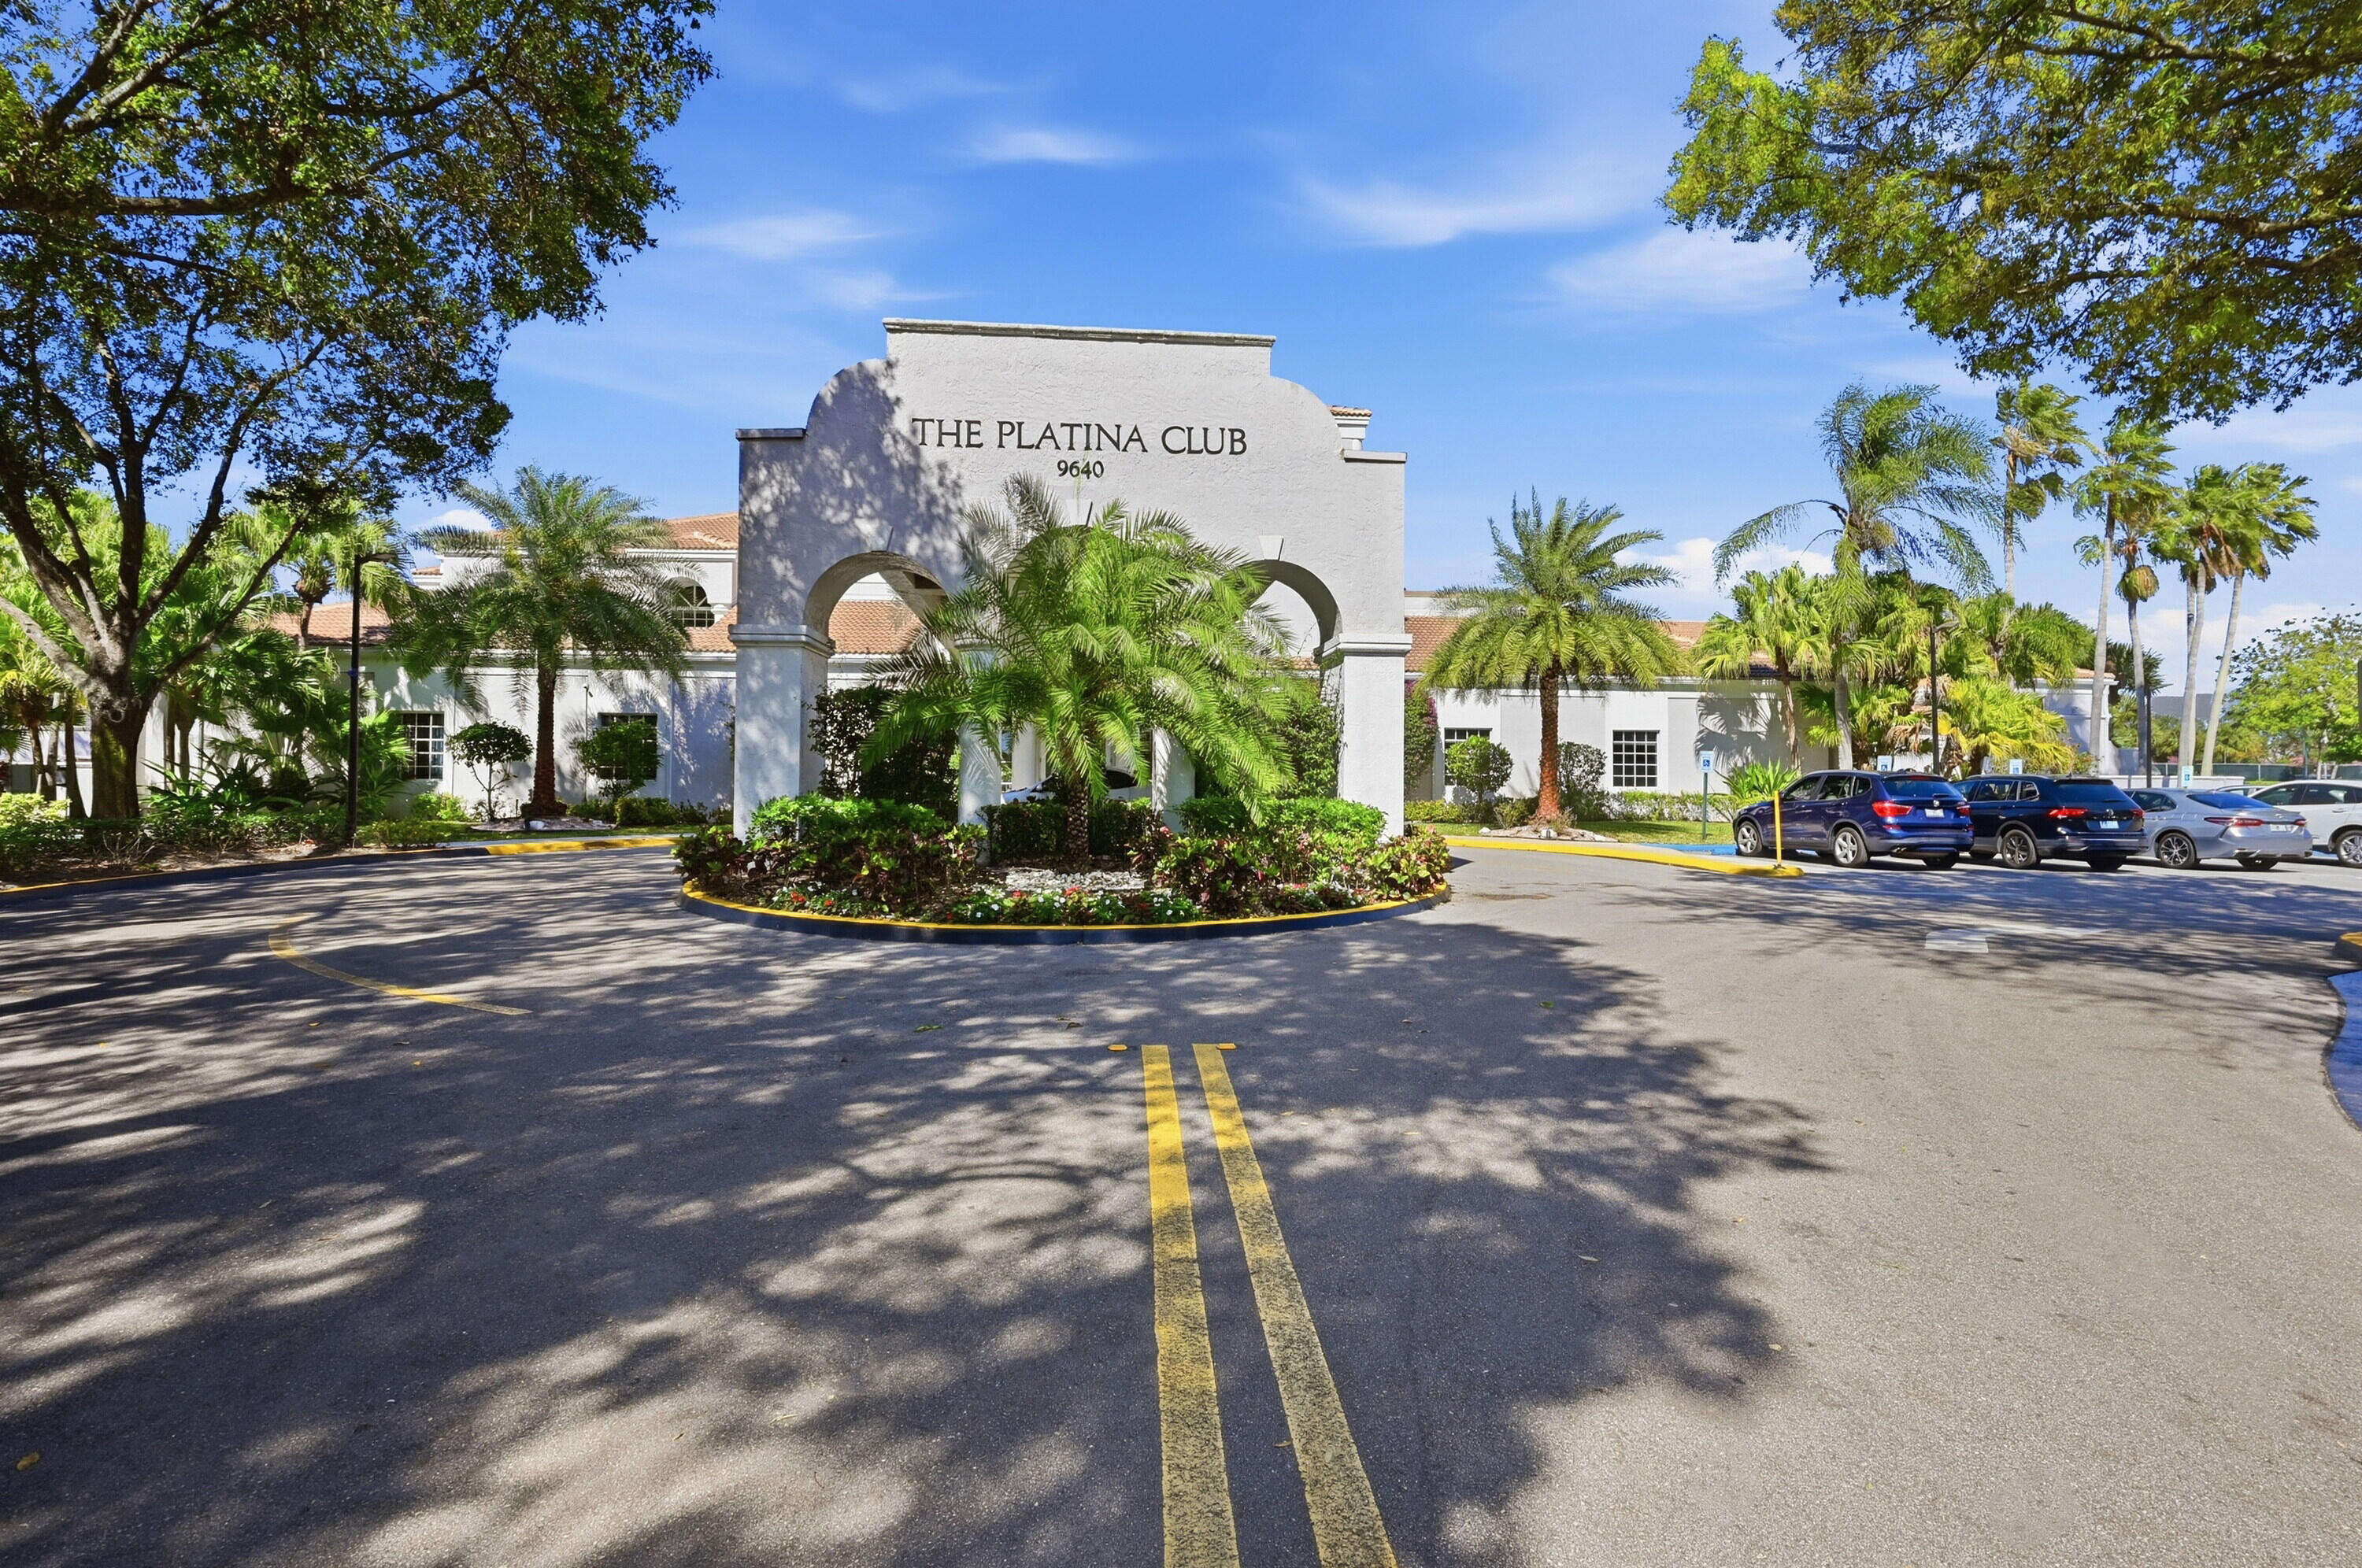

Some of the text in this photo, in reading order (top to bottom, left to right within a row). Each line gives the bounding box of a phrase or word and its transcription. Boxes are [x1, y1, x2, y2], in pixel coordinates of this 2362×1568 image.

[912, 418, 1248, 456] THE PLATINA CLUB
[1057, 460, 1105, 479] 9640
